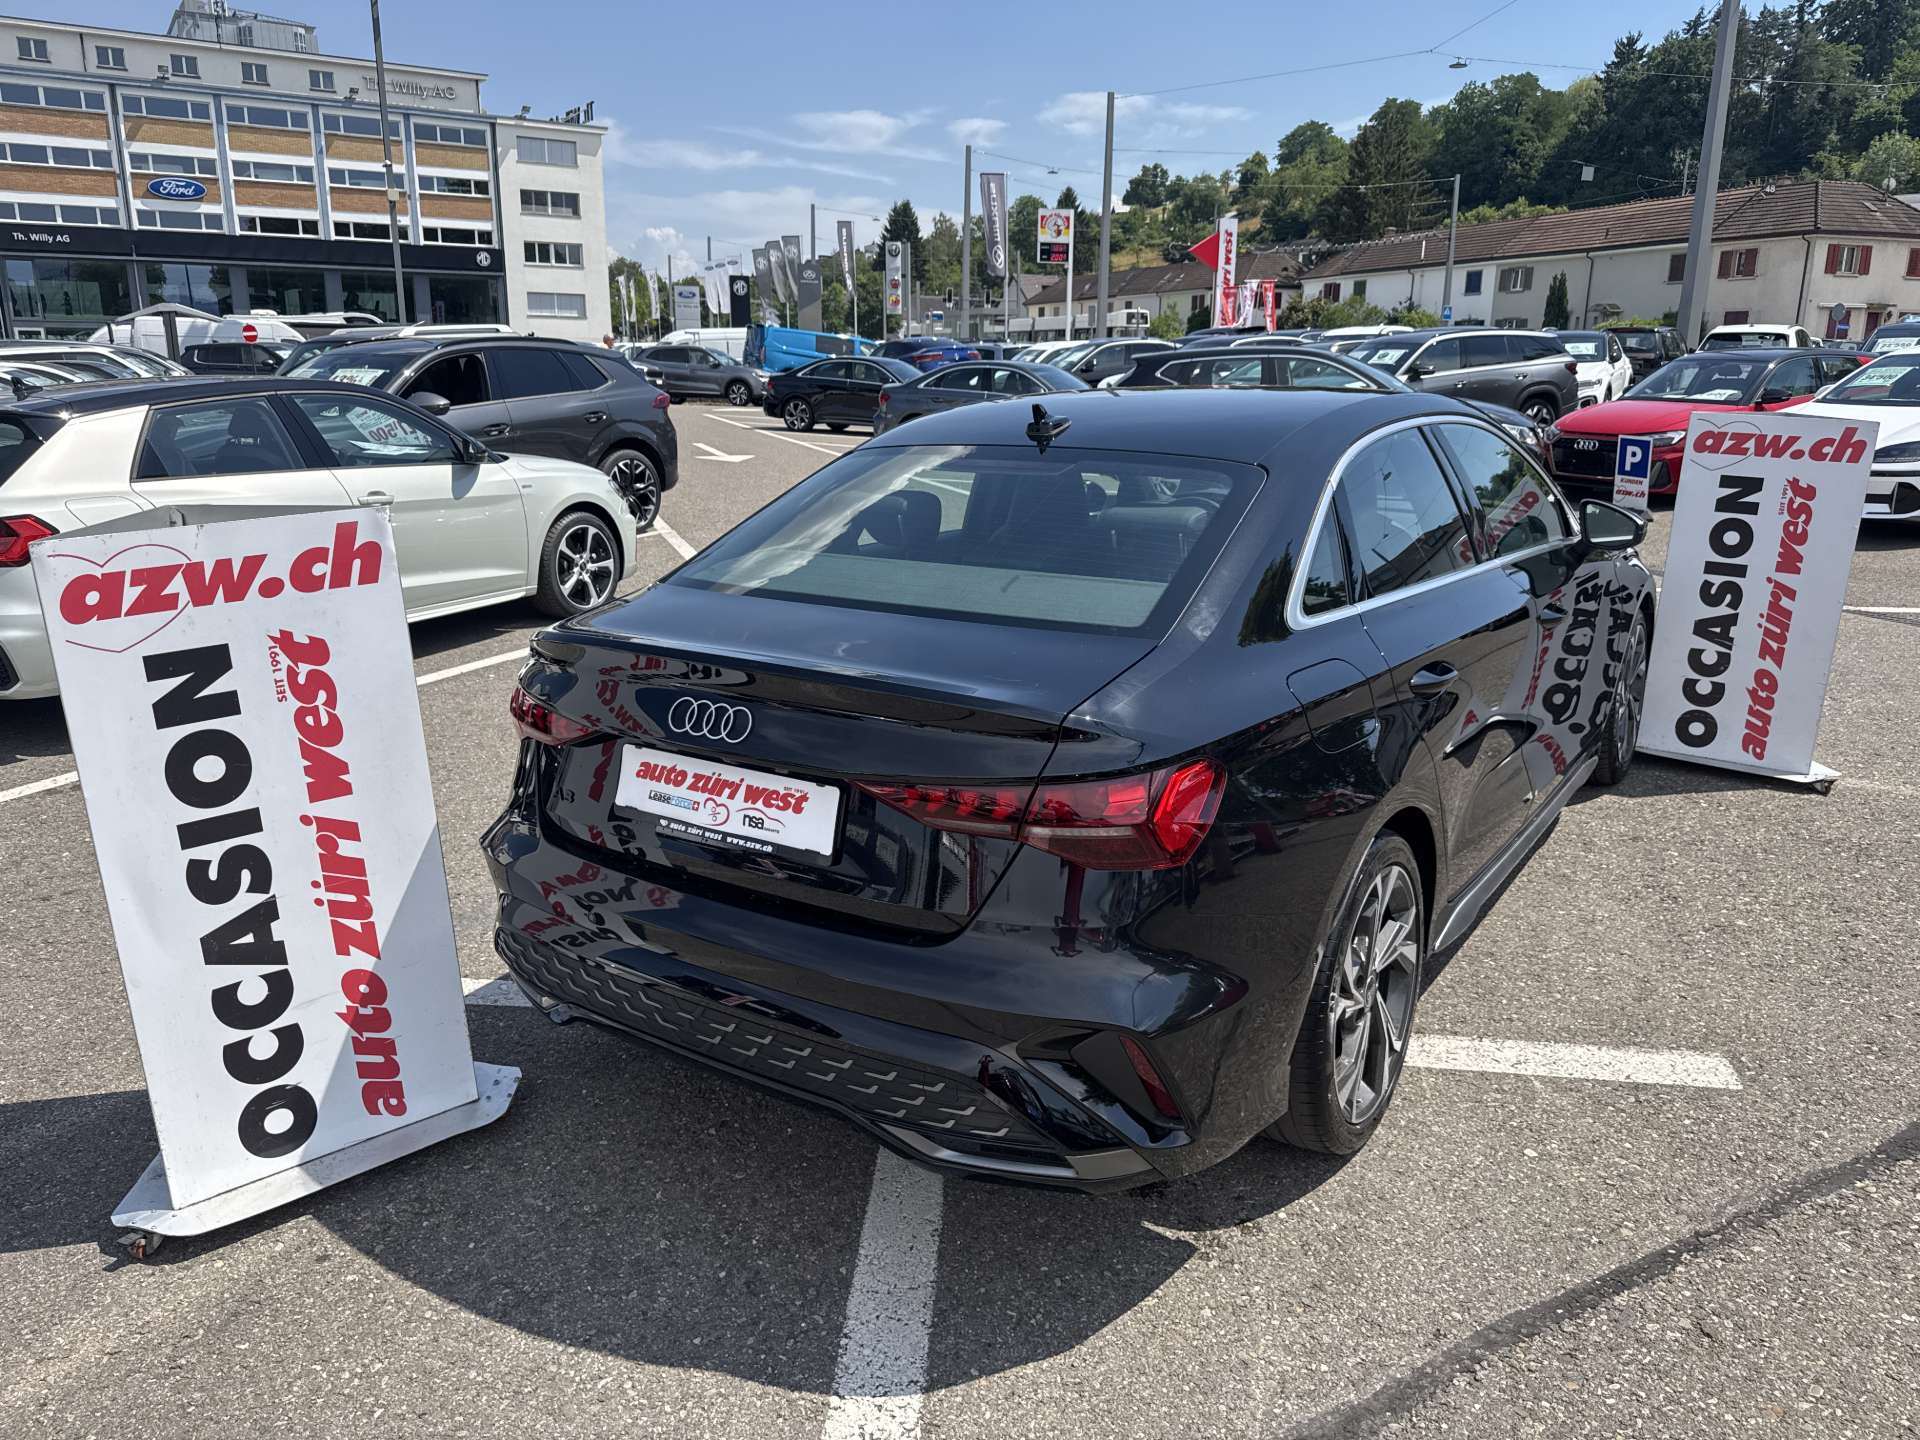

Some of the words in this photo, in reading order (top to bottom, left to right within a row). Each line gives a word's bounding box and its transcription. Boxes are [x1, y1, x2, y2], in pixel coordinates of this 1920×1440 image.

[392, 80, 427, 98] Willy
[432, 84, 456, 99] AG
[159, 180, 194, 196] Ford
[12, 232, 28, 240] Th.
[29, 233, 53, 244] Willy
[56, 234, 70, 243] AG
[1224, 229, 1233, 266] west
[476, 251, 491, 267] MG
[732, 280, 748, 296] MG
[1625, 445, 1642, 471] P
[1692, 427, 1869, 464] azw.ch
[1616, 489, 1646, 498] azw.ch
[1775, 476, 1817, 575] west
[58, 521, 382, 625] azw.ch
[1674, 474, 1765, 748] OCCASION
[1757, 576, 1797, 670] züri
[269, 645, 282, 673] 1991
[275, 675, 287, 703] SEIT
[266, 628, 354, 804] west
[1741, 669, 1779, 760] auto
[635, 760, 688, 788] auto
[687, 772, 745, 800] züri
[743, 784, 810, 814] west
[670, 822, 686, 831] auto
[687, 825, 704, 836] züri
[704, 831, 722, 840] west
[726, 836, 773, 852] www.azw.ch
[742, 814, 764, 830] nsa
[142, 642, 318, 1159] OCCASION
[299, 813, 382, 960] züri
[335, 968, 407, 1117] auto
